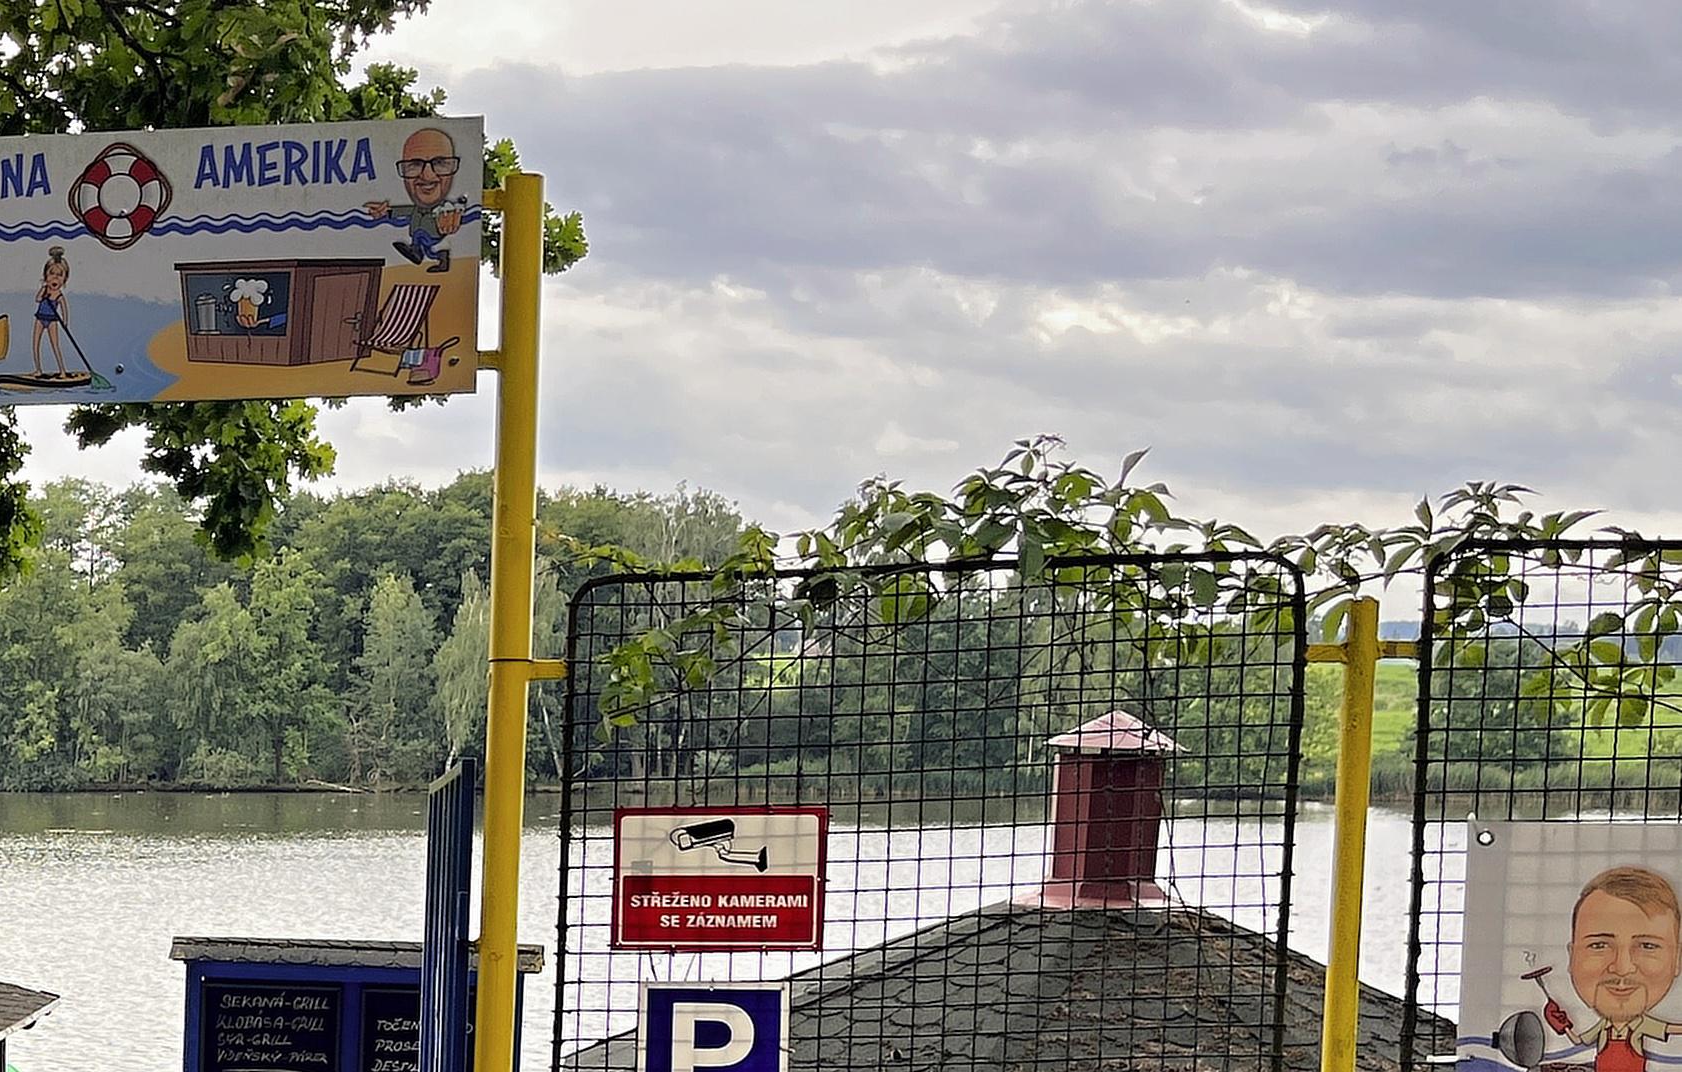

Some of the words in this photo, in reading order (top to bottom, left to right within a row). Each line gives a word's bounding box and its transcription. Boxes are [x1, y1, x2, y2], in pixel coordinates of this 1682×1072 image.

[194, 137, 378, 190] AMERIKA
[630, 889, 713, 909] STŘEŽENO
[718, 893, 808, 909] KAMERAMI
[659, 913, 681, 929] SE
[685, 910, 778, 929] ZÁZNAMEM
[376, 1018, 419, 1032] TOČEN
[375, 1039, 420, 1052] PROSE
[371, 1059, 419, 1072] DESTIL
